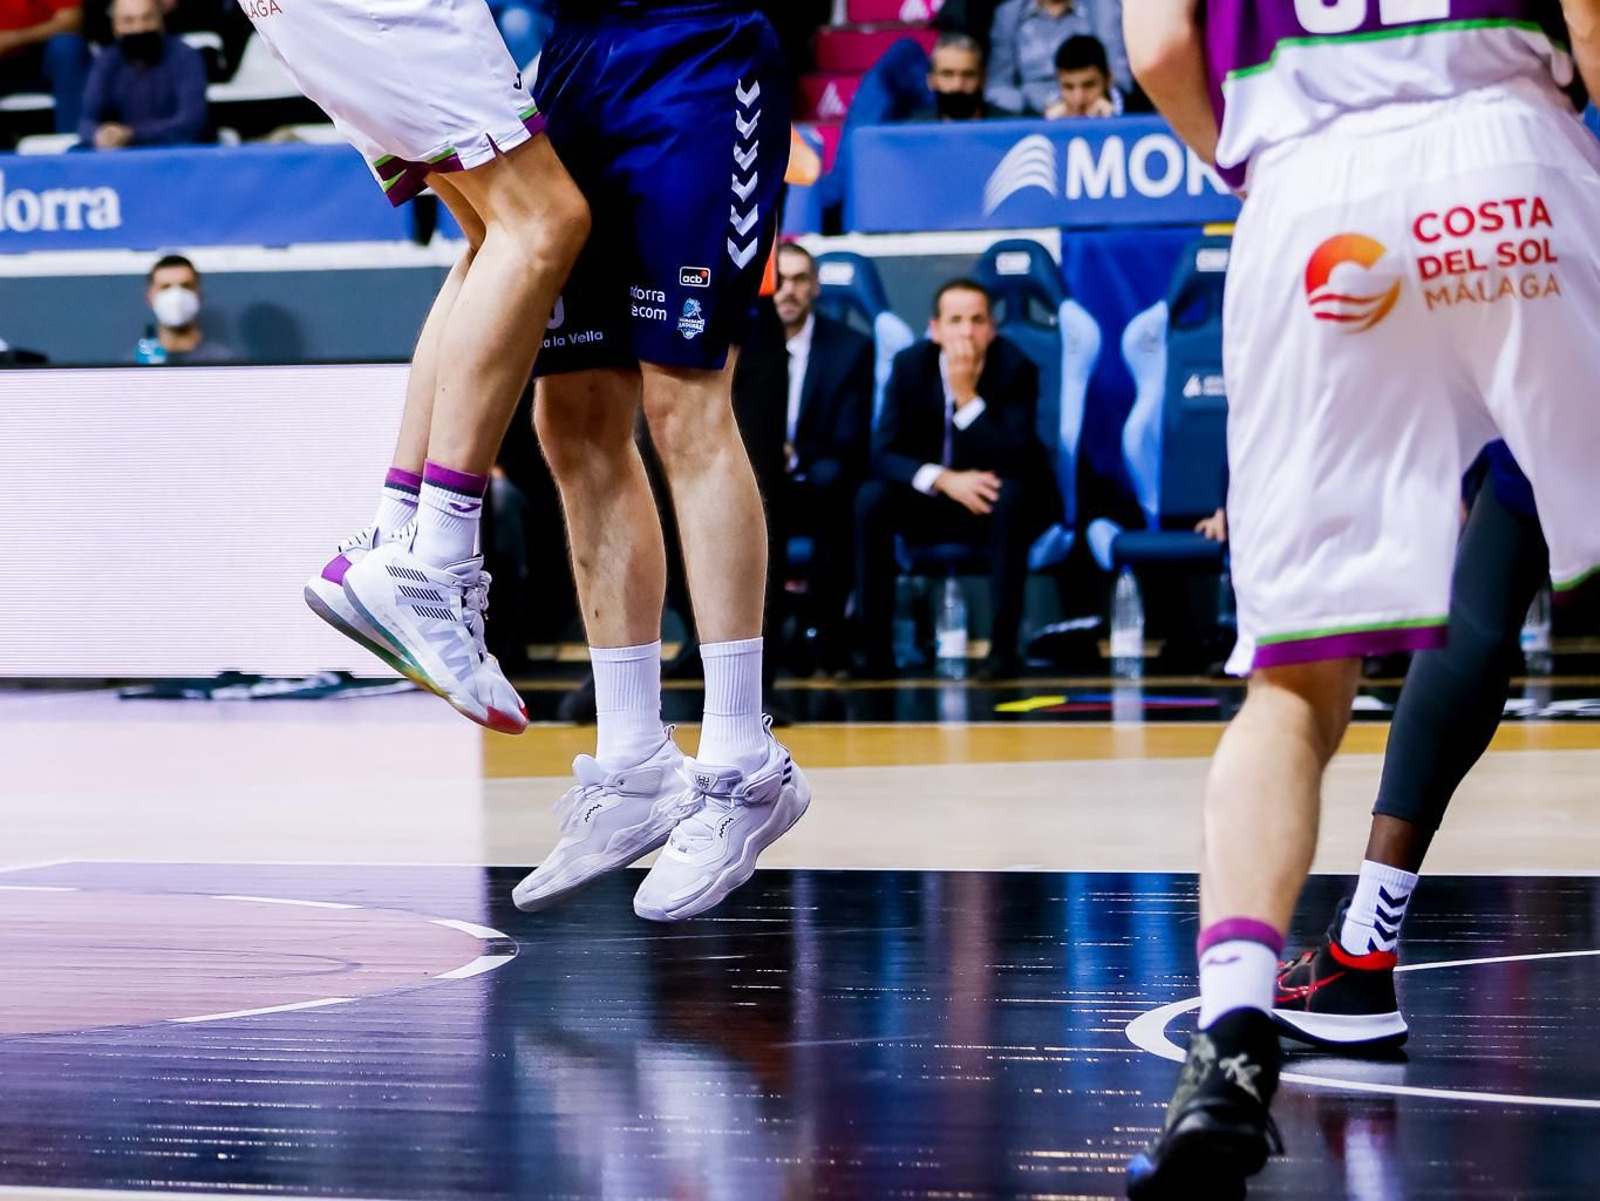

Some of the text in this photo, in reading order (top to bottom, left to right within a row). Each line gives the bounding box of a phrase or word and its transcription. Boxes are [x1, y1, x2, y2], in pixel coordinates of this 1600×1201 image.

[1412, 196, 1553, 244] COSTA
[1416, 238, 1559, 282] DEL SOL
[682, 273, 704, 284] acb
[567, 330, 604, 345] Vella
